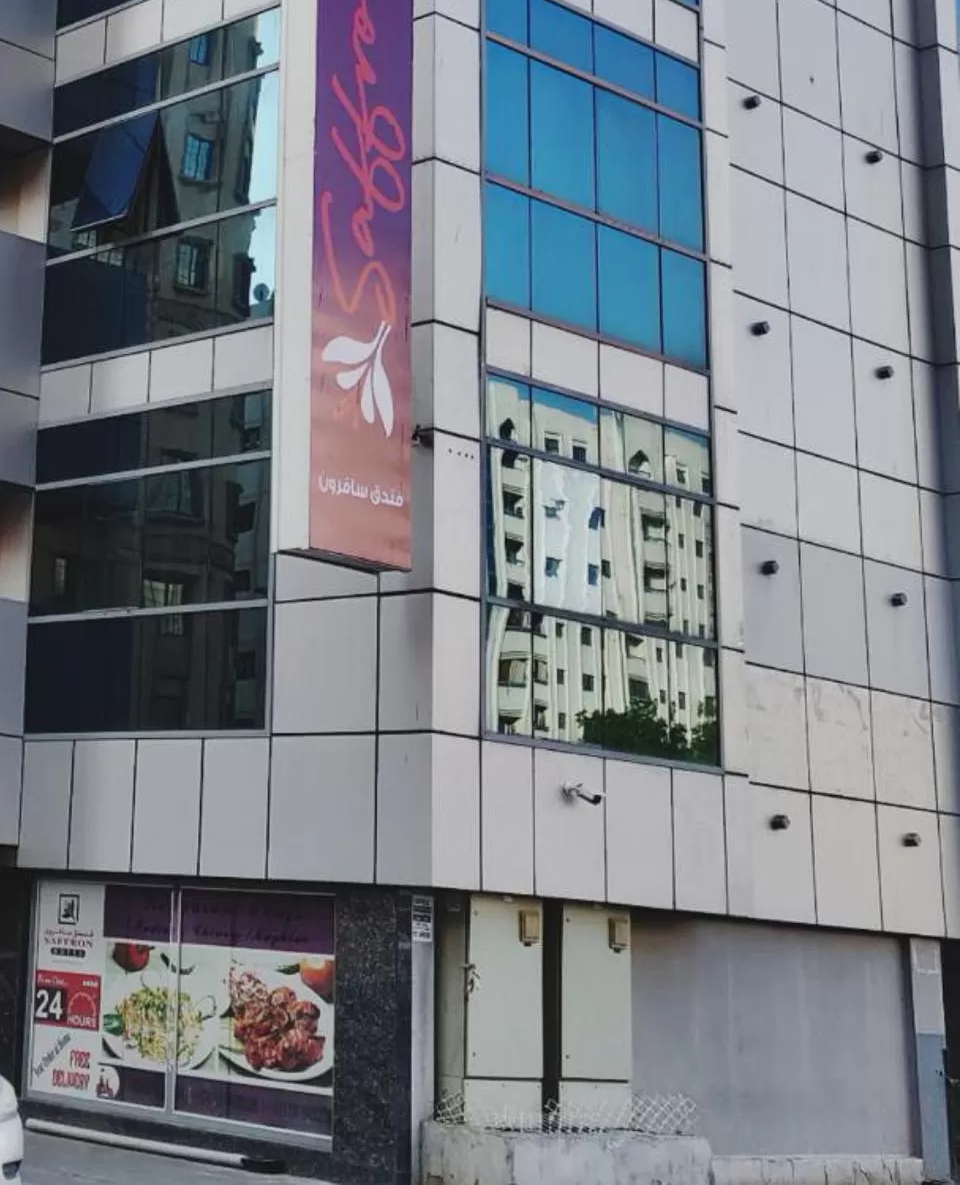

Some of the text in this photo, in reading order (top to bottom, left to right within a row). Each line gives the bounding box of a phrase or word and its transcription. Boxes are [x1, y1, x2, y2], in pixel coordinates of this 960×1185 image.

[318, 471, 405, 508] فندق سافرون
[43, 936, 94, 948] SAFFRON
[35, 989, 64, 1020] 24
[66, 1014, 98, 1028] HOURS
[69, 1050, 91, 1070] FREE
